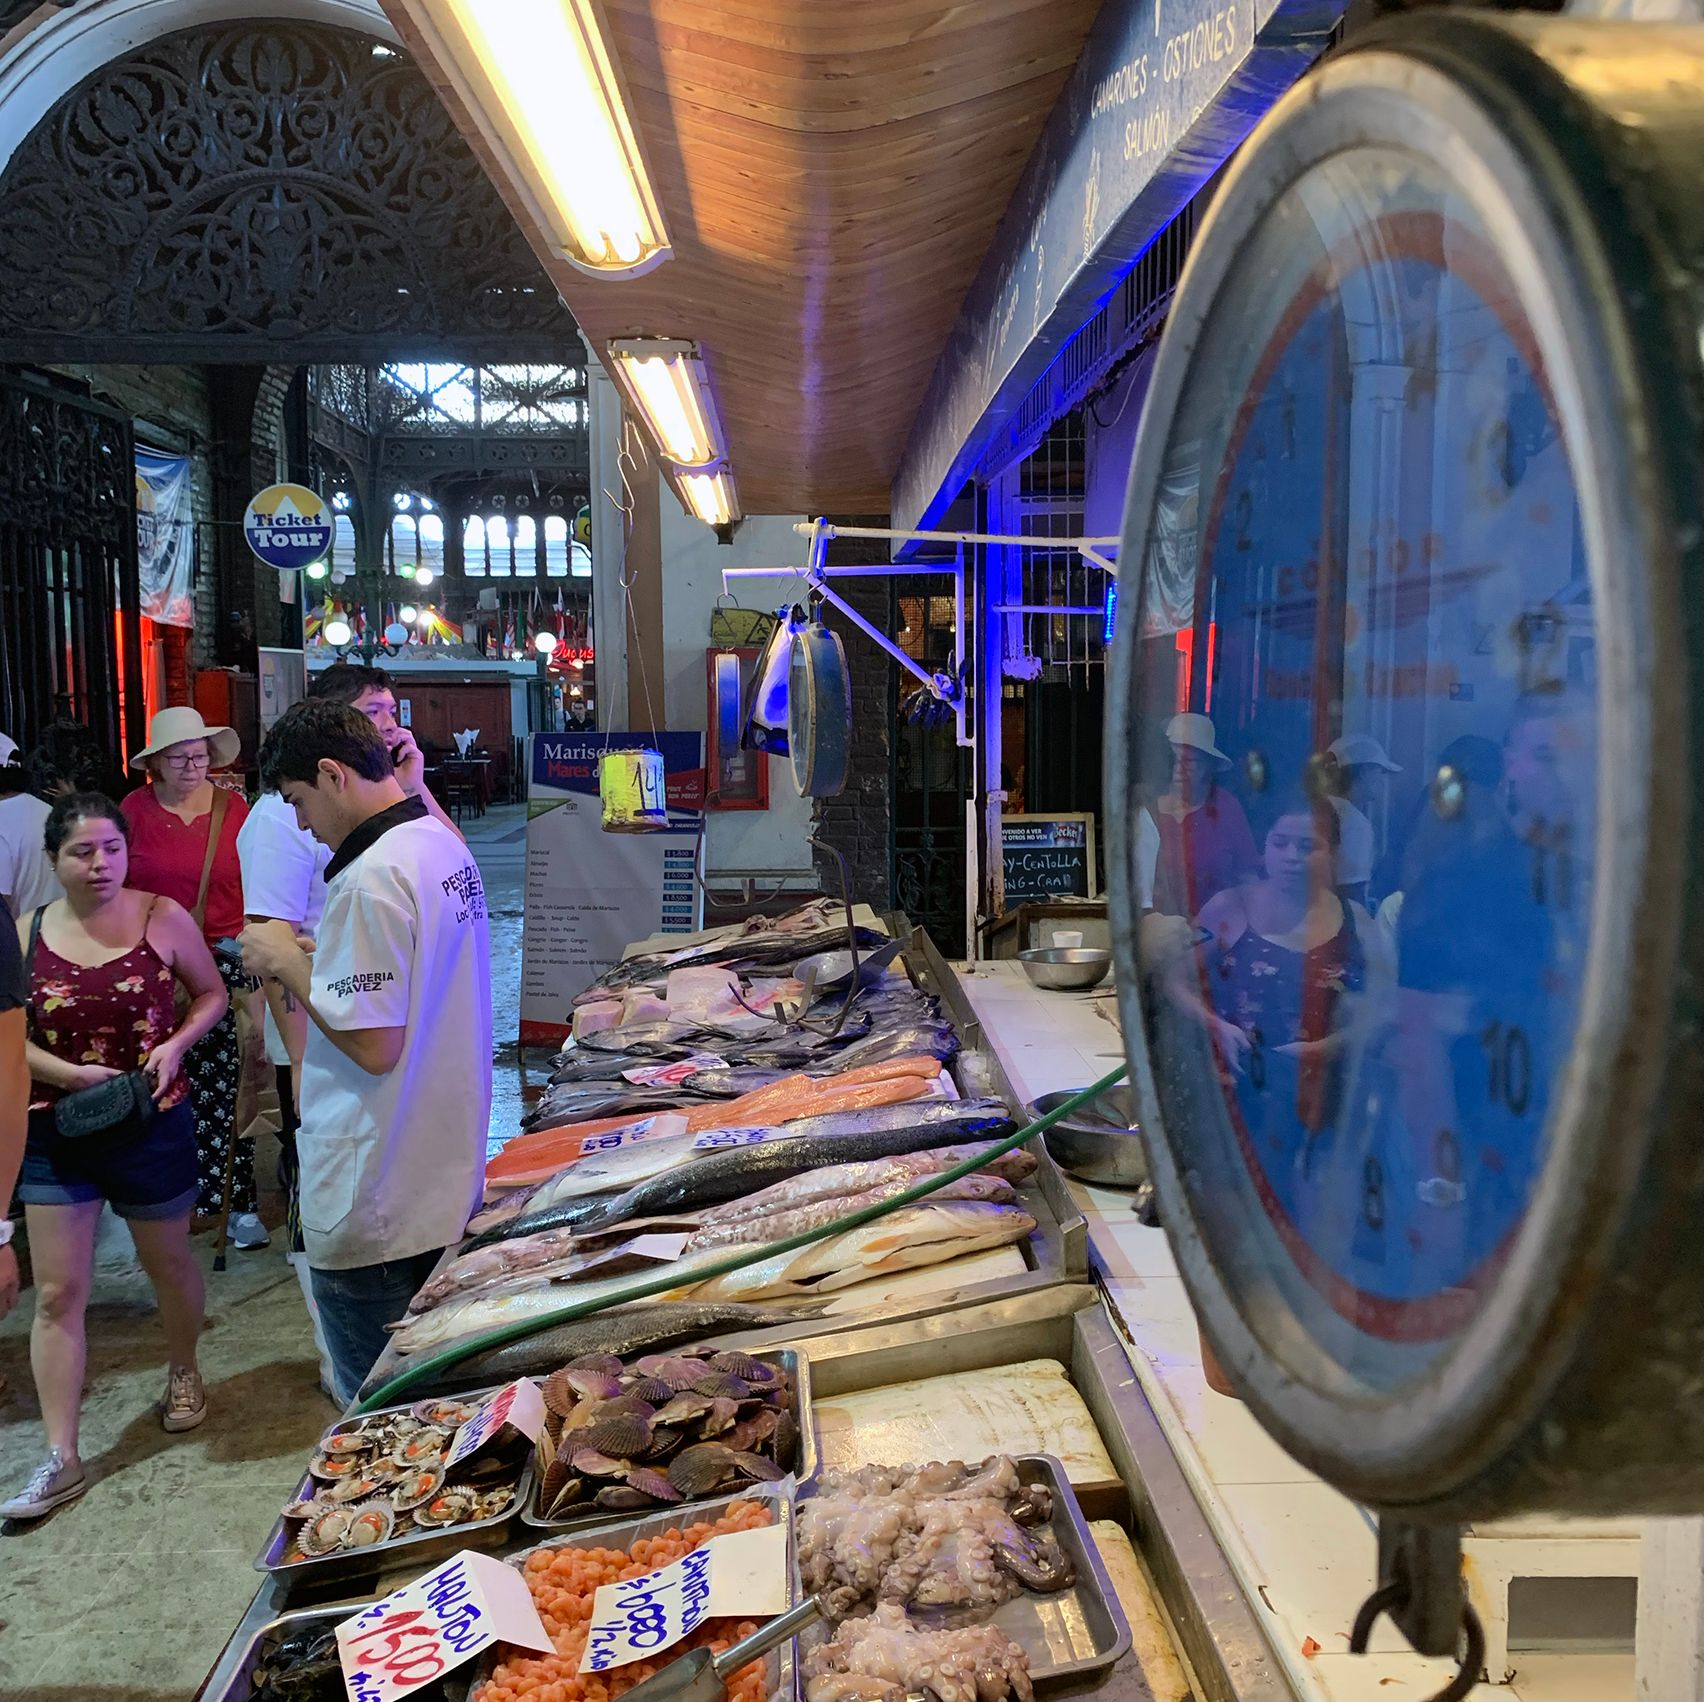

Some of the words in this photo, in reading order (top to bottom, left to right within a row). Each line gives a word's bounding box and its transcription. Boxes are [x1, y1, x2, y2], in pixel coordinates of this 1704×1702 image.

[1091, 53, 1148, 120] CAMARONES
[1163, 5, 1236, 83] OSTIONES
[253, 513, 322, 527] Ticket
[253, 529, 323, 548] Tour
[327, 972, 395, 991] PESCADERIA
[338, 981, 382, 998] PAVEZ
[1483, 1022, 1532, 1117] 10
[346, 1610, 445, 1685] 1500
